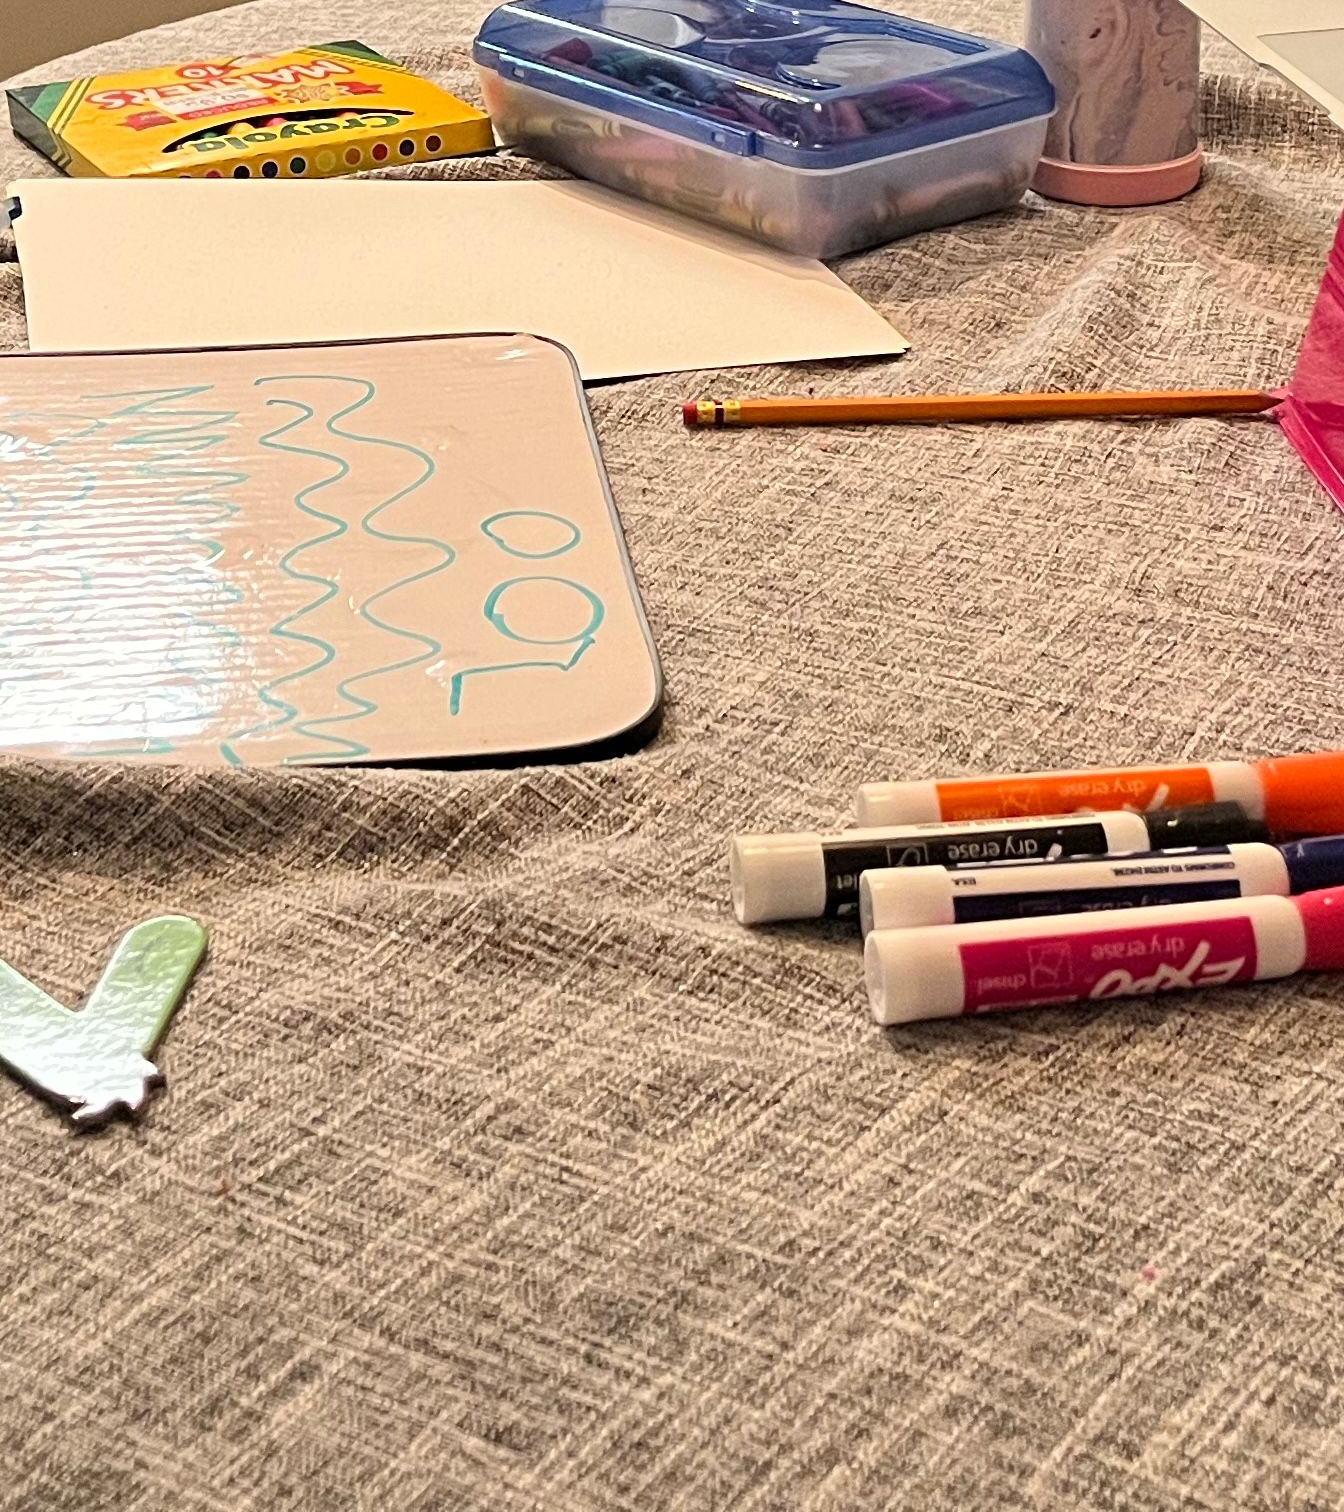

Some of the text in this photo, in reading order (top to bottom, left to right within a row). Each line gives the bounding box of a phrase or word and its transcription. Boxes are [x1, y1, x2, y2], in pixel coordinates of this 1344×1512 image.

[189, 115, 400, 153] Crayola
[1057, 777, 1147, 798] dry erase
[948, 835, 1038, 861] dry erase
[1089, 934, 1185, 961] dry erase
[1088, 939, 1246, 999] EXPO
[975, 973, 1026, 994] chisel
